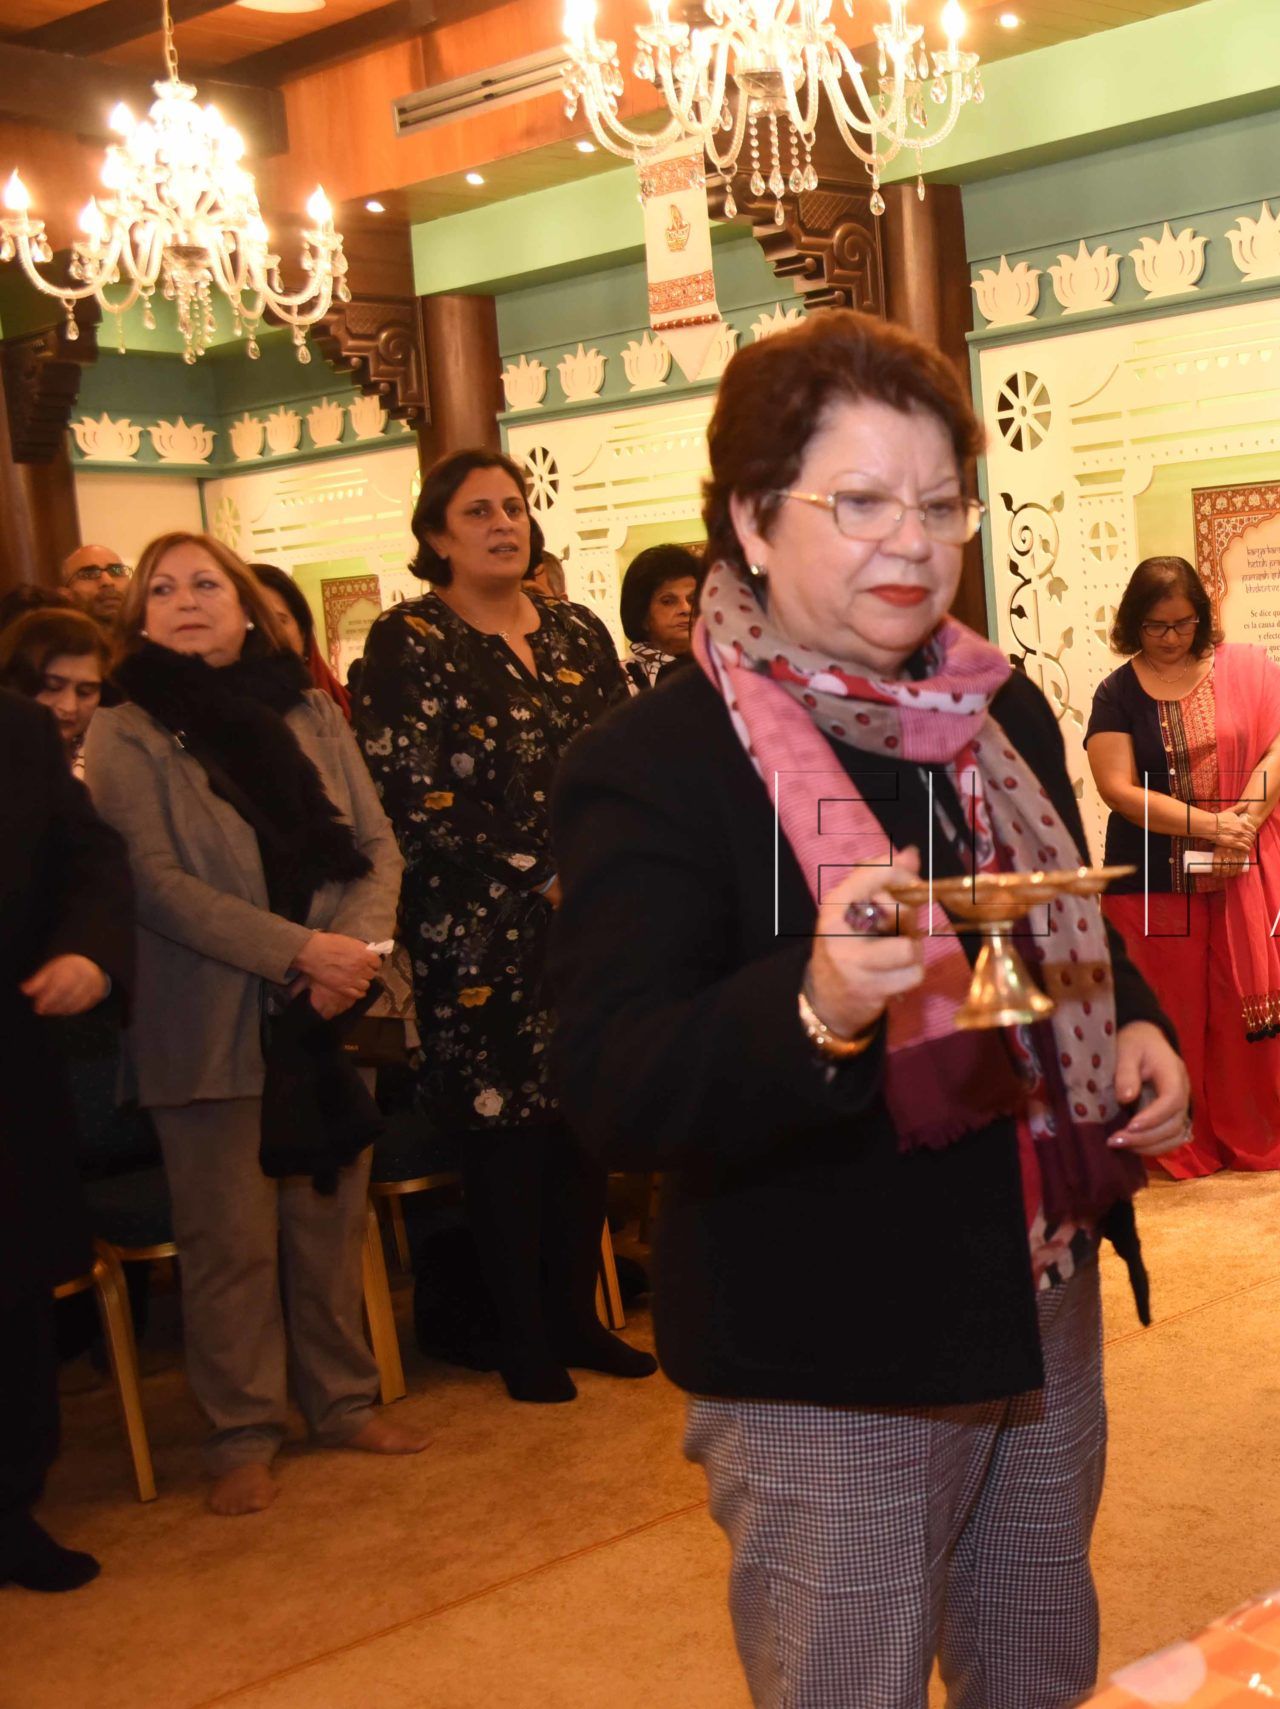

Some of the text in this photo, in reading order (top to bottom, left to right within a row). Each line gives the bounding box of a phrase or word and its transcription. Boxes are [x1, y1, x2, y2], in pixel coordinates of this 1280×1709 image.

[1250, 609, 1258, 618] Se
[1259, 609, 1271, 617] dice
[1251, 621, 1257, 629] la
[1258, 621, 1275, 629] causa
[1268, 644, 1280, 653] que
